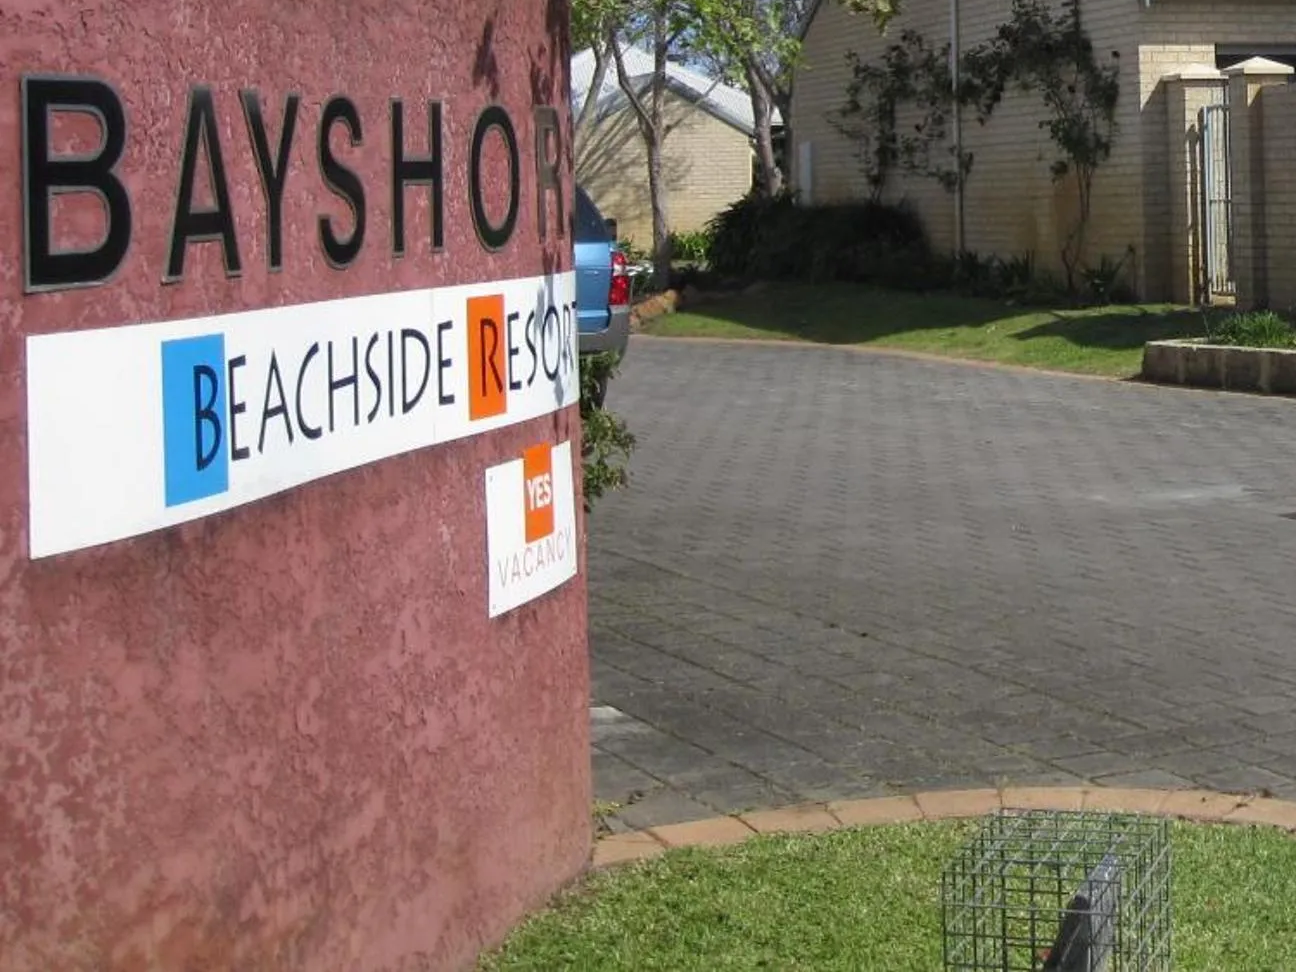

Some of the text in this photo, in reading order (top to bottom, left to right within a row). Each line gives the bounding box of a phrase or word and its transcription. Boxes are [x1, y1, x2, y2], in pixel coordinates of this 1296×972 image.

[22, 75, 566, 293] BAYSHOR
[193, 320, 455, 471] BEACHSIDE
[526, 473, 552, 511] YES
[498, 527, 572, 587] VACANCY
